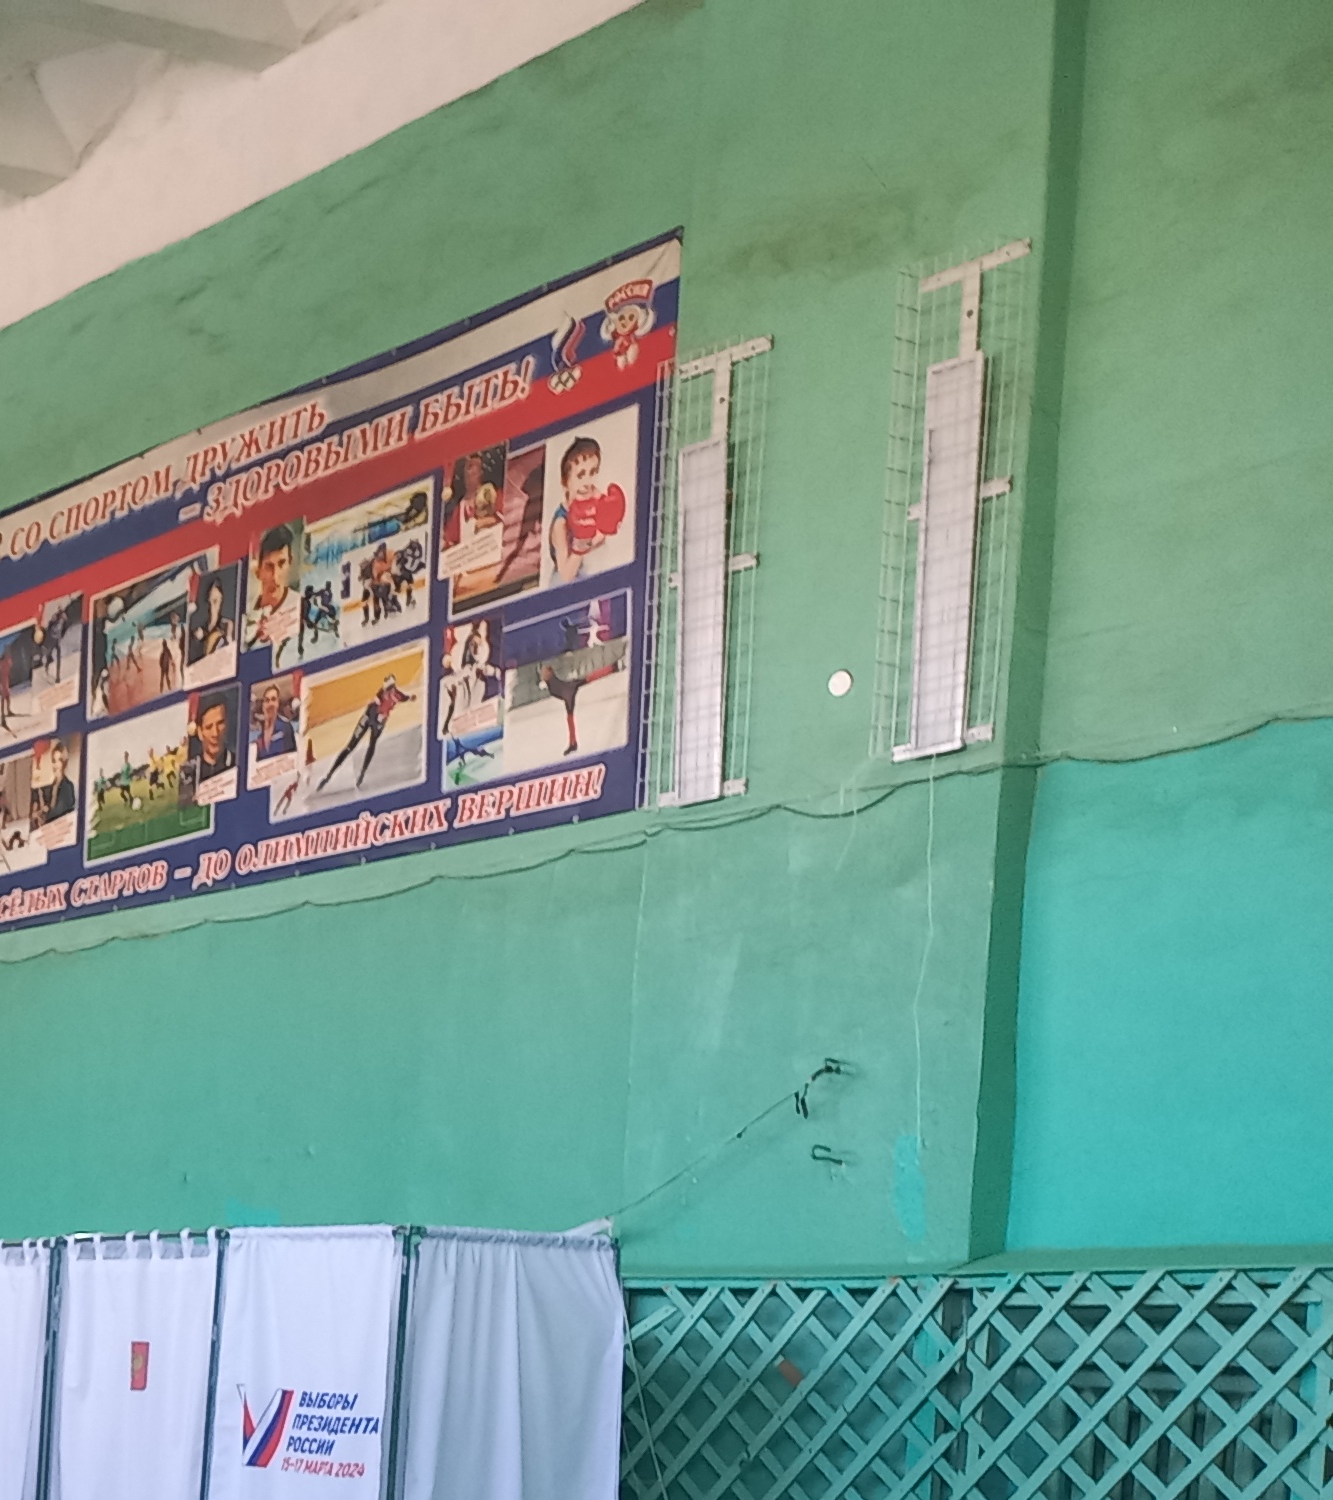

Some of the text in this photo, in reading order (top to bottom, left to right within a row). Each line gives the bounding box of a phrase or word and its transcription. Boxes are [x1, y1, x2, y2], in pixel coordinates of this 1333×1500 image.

[205, 407, 409, 522] ЗДОРОВЫМИ
[418, 356, 535, 436] БЫТЬ!
[9, 402, 328, 557] СО СПОРТОМ ДРУЖИТЬ
[71, 861, 168, 906] СТАРТОВ
[192, 849, 231, 889] ДО
[236, 798, 450, 874] ОЛИМПИЙСКИХ
[455, 764, 606, 829] ВЕРШИН!
[298, 1390, 359, 1411] ВЫБОРЫ
[291, 1413, 380, 1436] ПРЕЗИДЕНТА
[285, 1436, 336, 1456] РОССИИ
[280, 1456, 365, 1478] 15-17 МАРТА 2024
